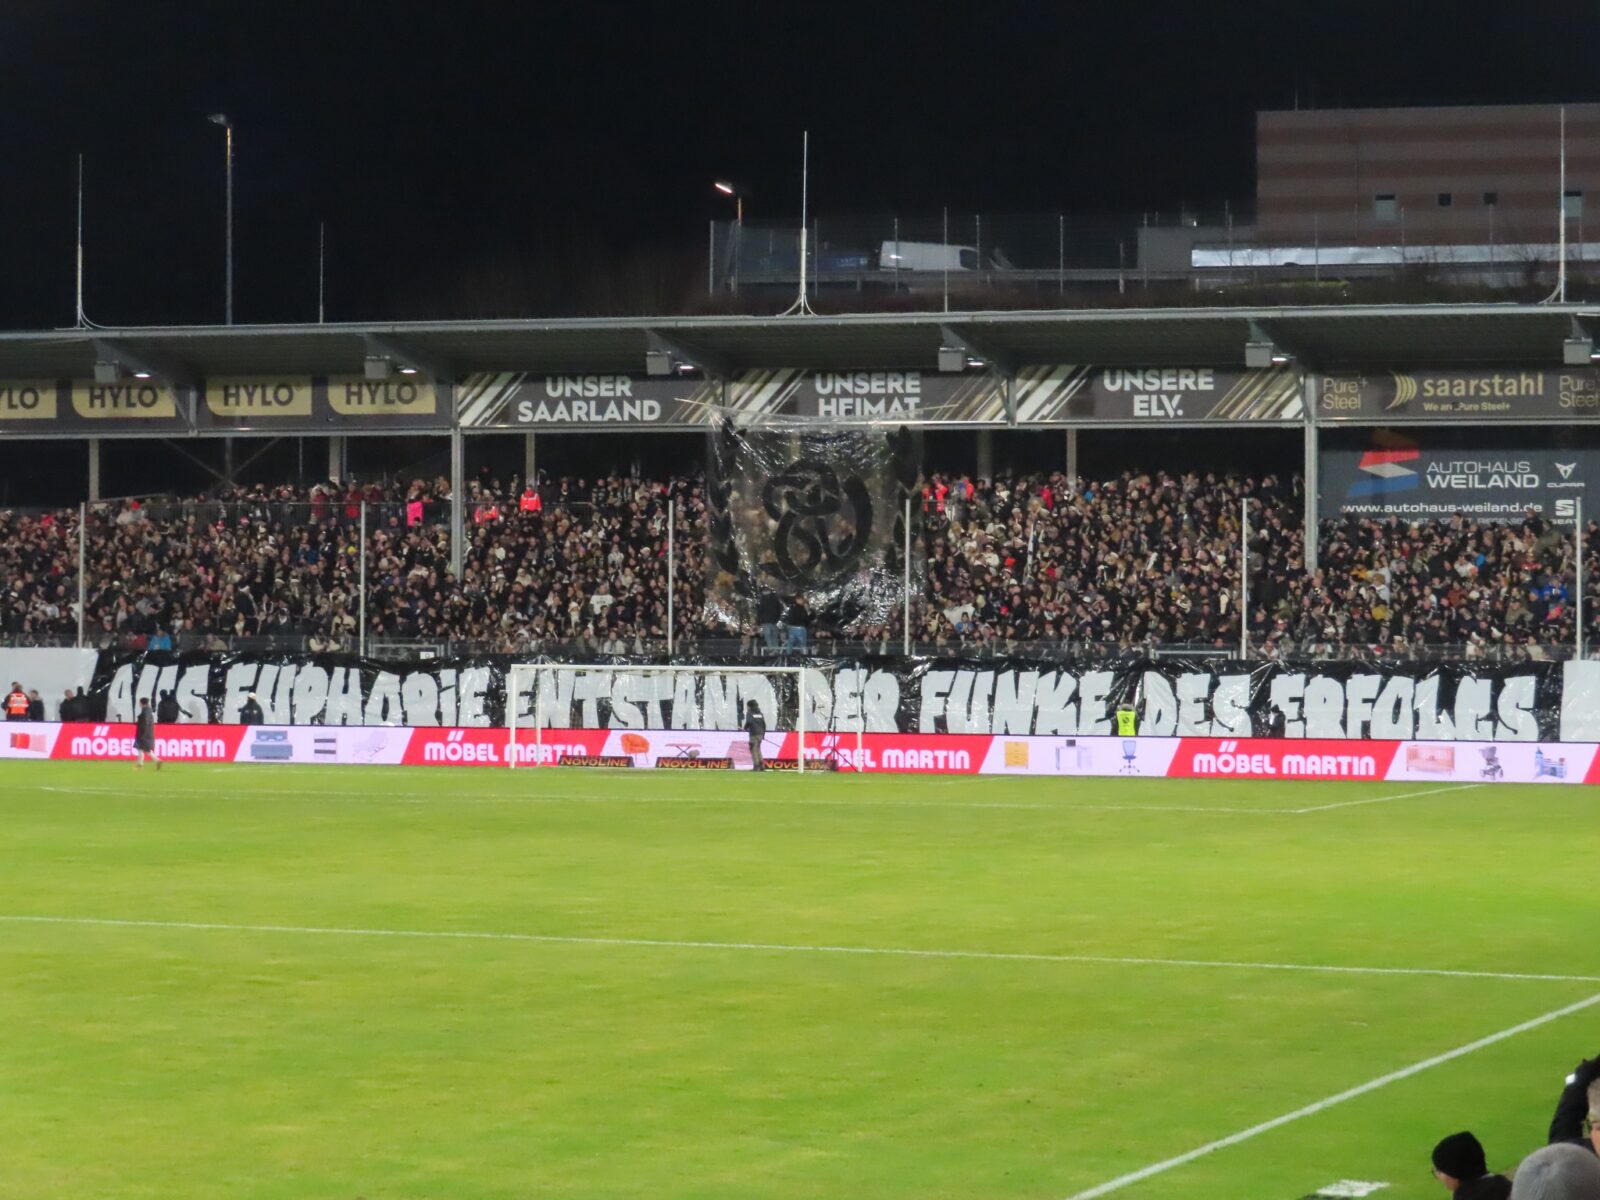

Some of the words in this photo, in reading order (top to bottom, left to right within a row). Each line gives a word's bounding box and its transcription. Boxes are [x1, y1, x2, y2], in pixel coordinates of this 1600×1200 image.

[546, 375, 632, 398] UNSER
[815, 372, 921, 395] UNSERE
[1103, 369, 1215, 391] UNSERE
[1423, 373, 1544, 397] saarstahl
[518, 399, 661, 422] SAARLAND
[818, 396, 920, 418] HEIMAT
[1133, 394, 1184, 418] ELV.
[1323, 394, 1361, 410] Steel
[1426, 461, 1530, 473] AUTOHAUS
[1426, 474, 1540, 489] WEILAND
[1343, 501, 1543, 513] www.autohaus-weiland.de
[105, 663, 210, 724] AUS
[506, 667, 778, 732] ENTSTAND
[796, 667, 900, 734] DER
[919, 669, 1115, 736] FUNKE
[1138, 672, 1253, 738] DES
[1270, 674, 1540, 741] ERFOLGS
[424, 730, 498, 761] MÖBEL
[560, 756, 628, 768] NOVOLINE
[658, 757, 728, 769] NOVOLINE
[882, 748, 970, 769] MARTIN
[1193, 740, 1277, 774] MÖBEL
[1282, 754, 1376, 775] MARTIN
